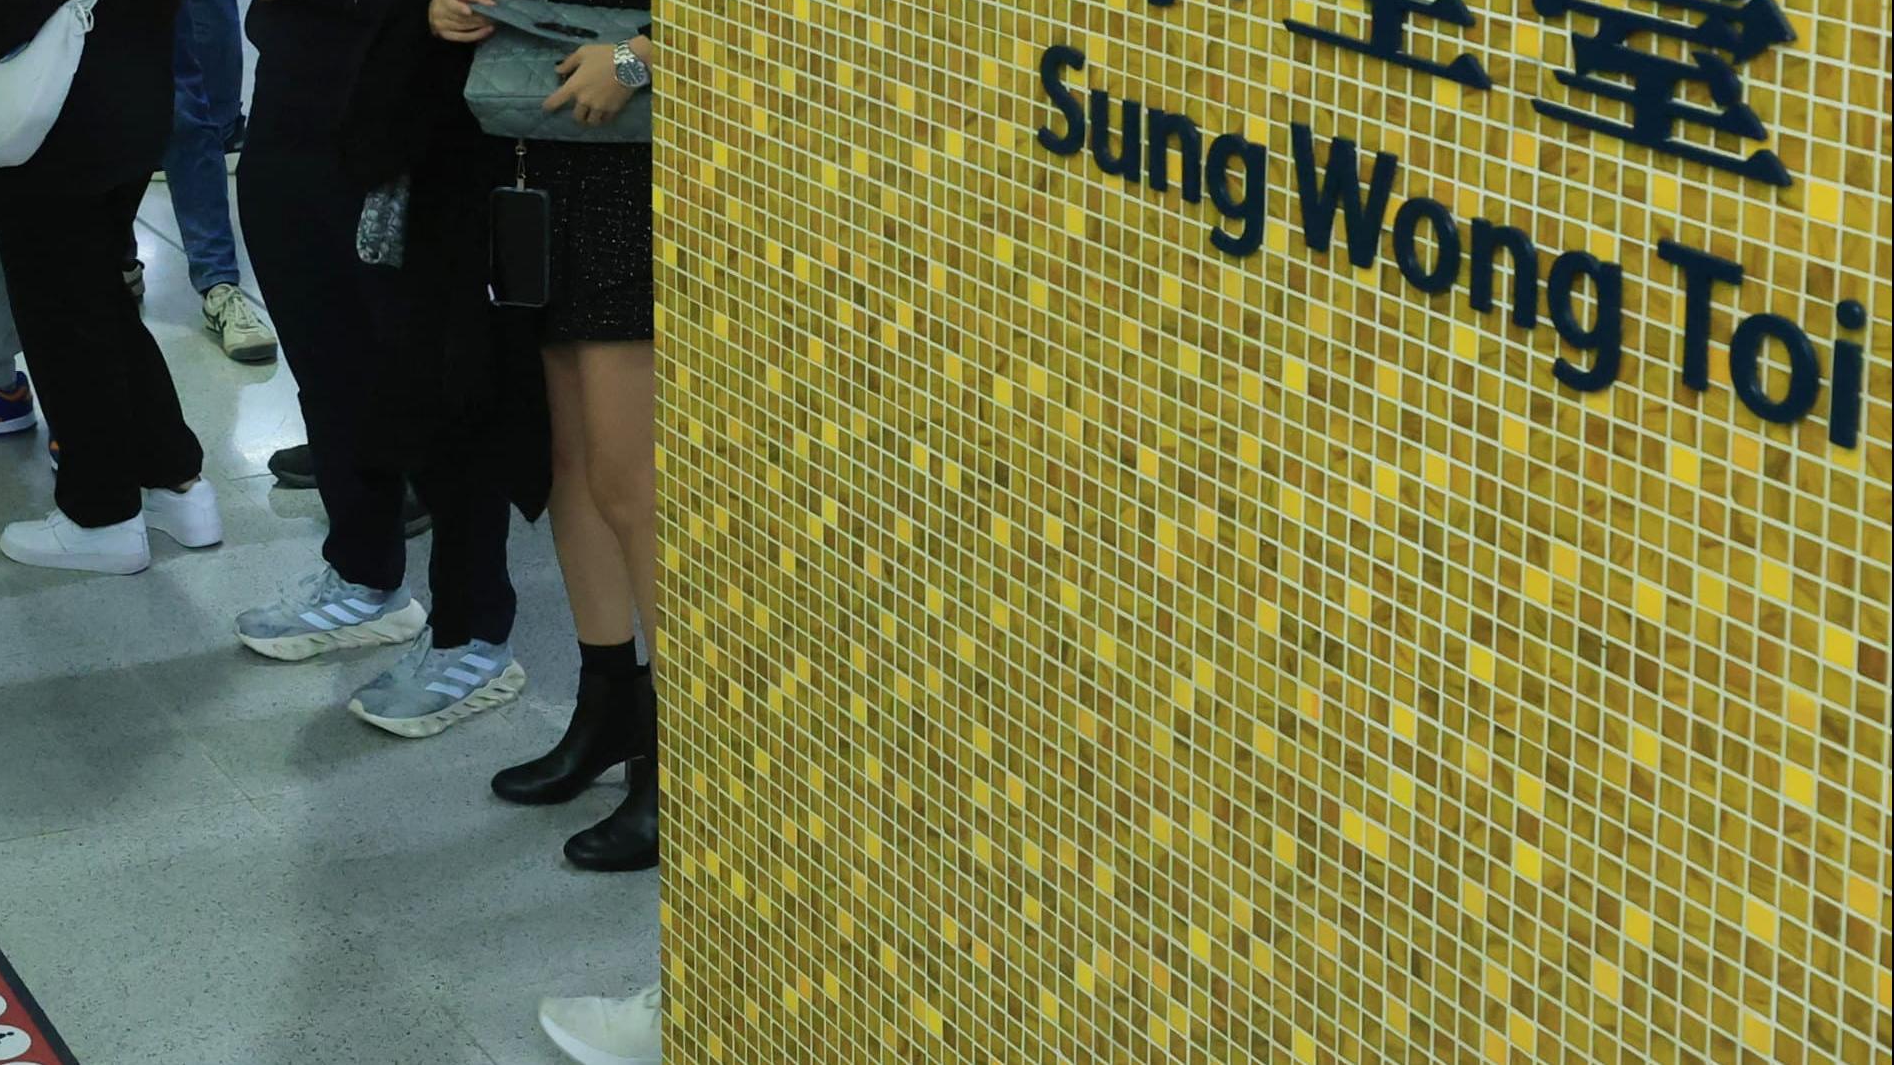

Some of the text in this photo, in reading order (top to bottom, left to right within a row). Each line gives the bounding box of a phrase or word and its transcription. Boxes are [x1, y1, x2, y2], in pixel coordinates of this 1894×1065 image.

[1037, 44, 1867, 450] Sung Wong Toi
